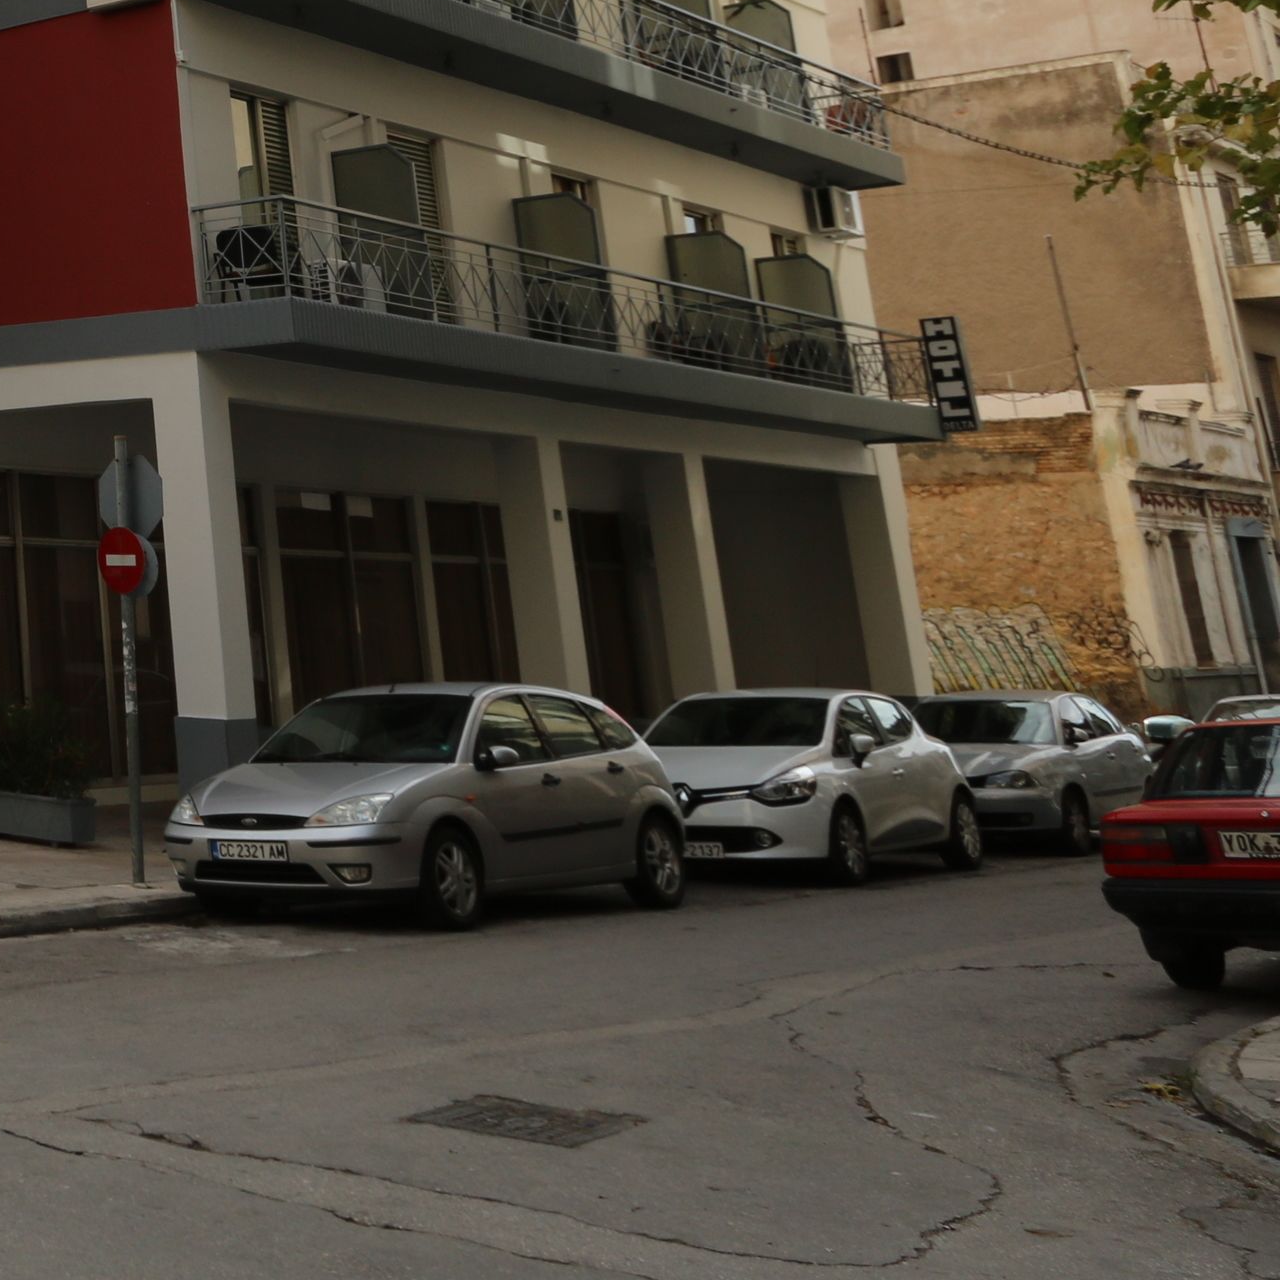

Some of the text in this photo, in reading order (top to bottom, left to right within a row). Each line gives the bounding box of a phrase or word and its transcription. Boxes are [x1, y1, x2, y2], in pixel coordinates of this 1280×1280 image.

[923, 319, 971, 418] HOTEL
[220, 843, 286, 859] CC 2321 AM
